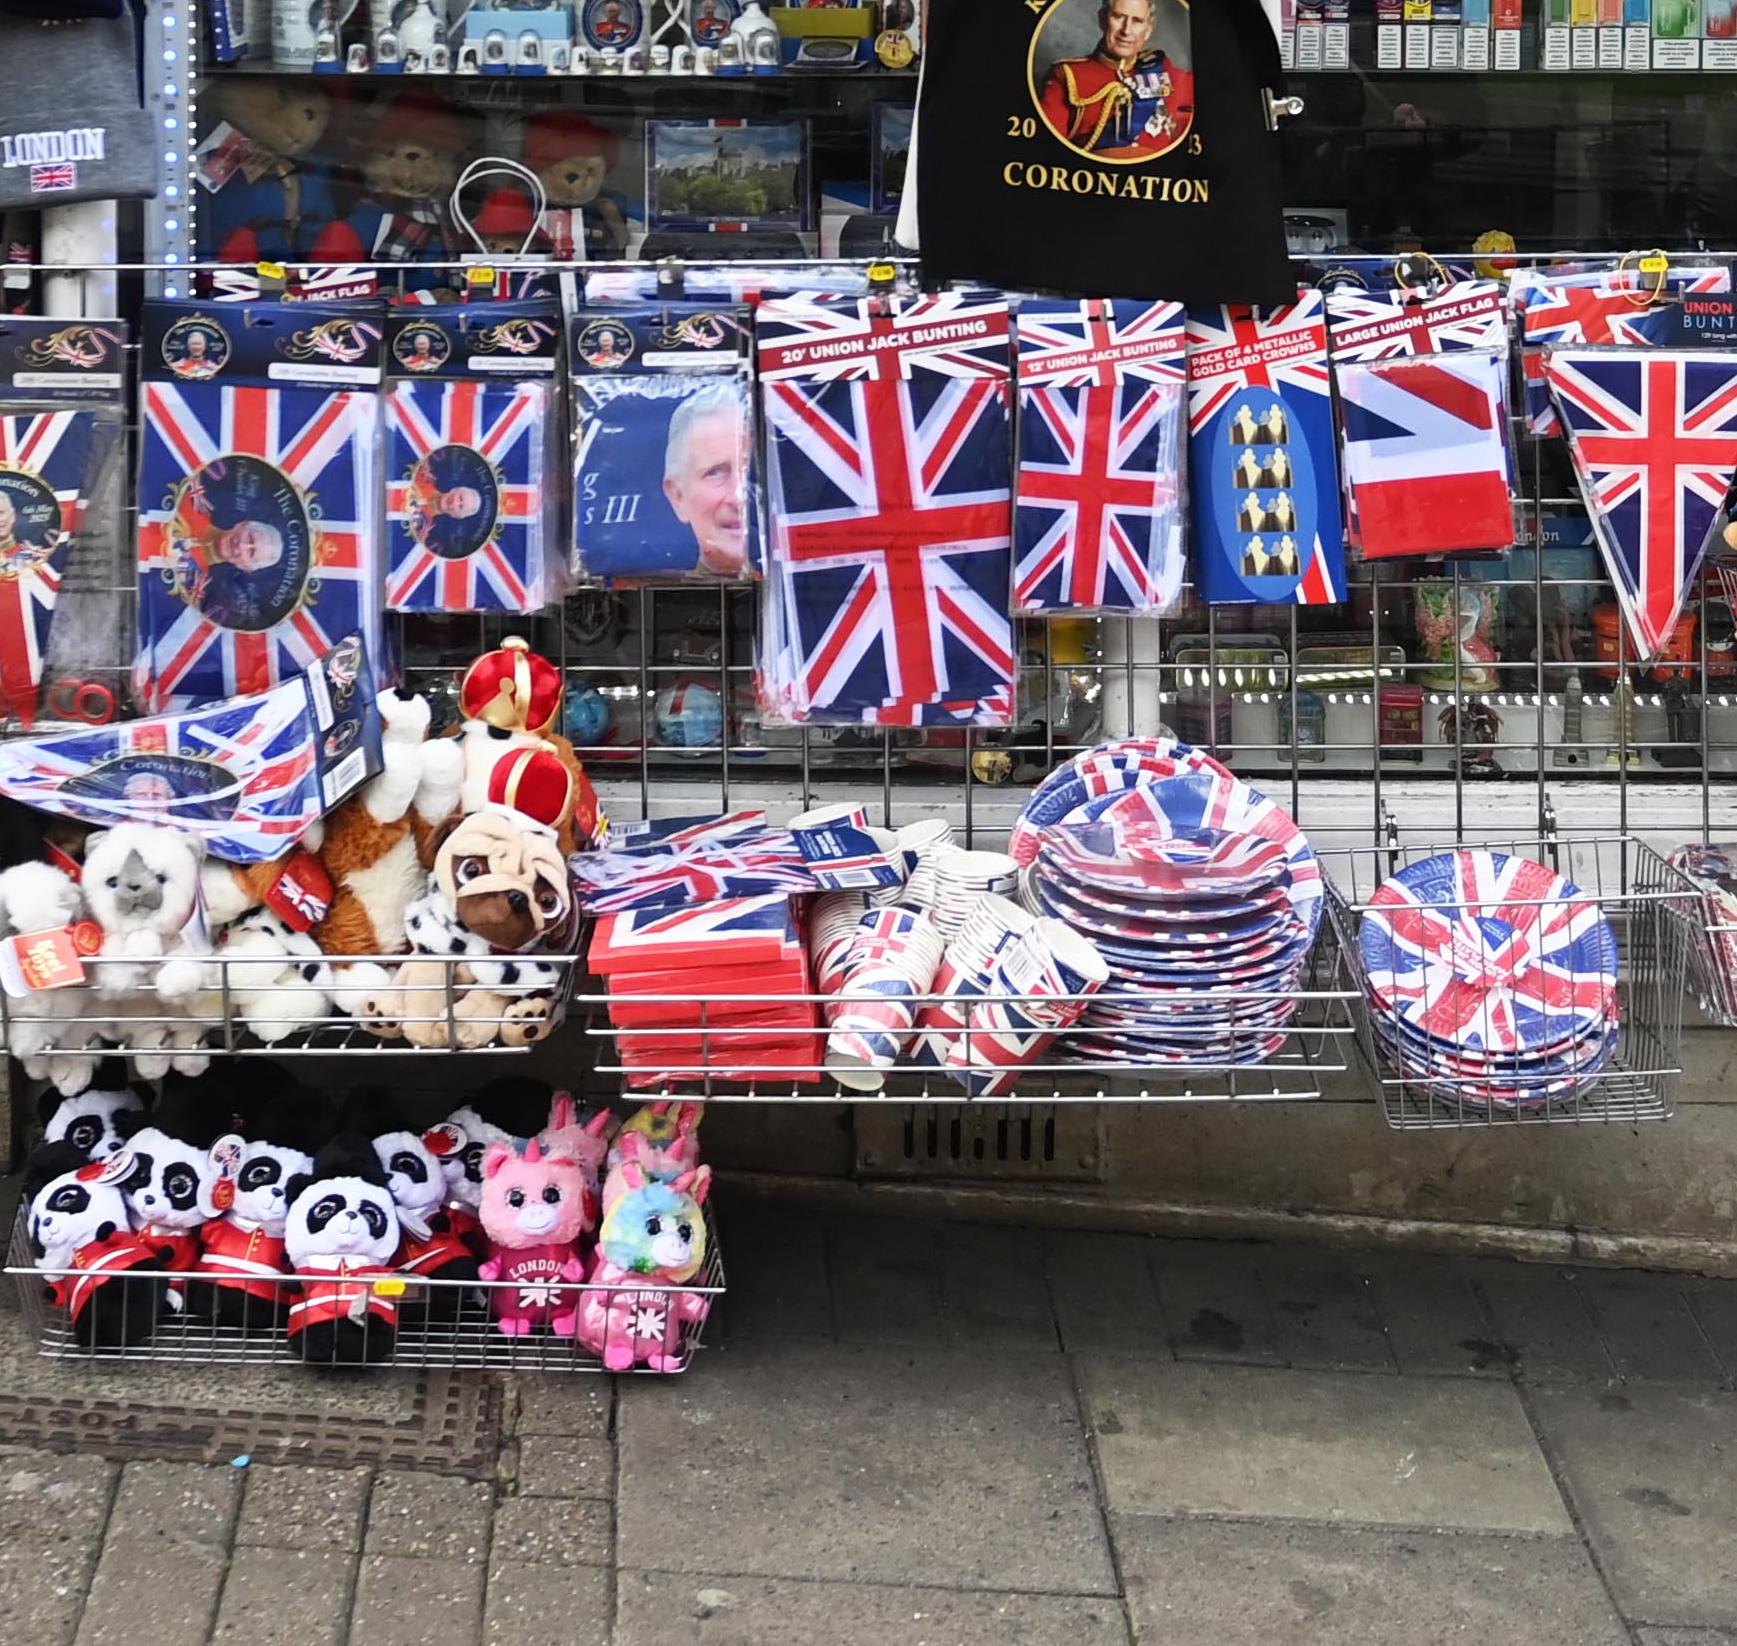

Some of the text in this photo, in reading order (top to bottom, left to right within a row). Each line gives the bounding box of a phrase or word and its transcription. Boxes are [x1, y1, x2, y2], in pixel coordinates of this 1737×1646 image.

[1007, 115, 1038, 138] 20
[0, 127, 106, 167] LONDON
[1002, 161, 1210, 204] CORONATION
[307, 282, 372, 303] JACK FLAG
[1683, 300, 1733, 317] UNION
[809, 337, 865, 362] UNION
[866, 331, 910, 353] JACK
[911, 318, 989, 348] BUNTING
[1335, 297, 1495, 347] LARGE UNION JACK FLAG
[1048, 354, 1086, 371] UNION
[1088, 348, 1119, 366] JACK
[1121, 337, 1178, 361] BUNTING
[1191, 329, 1313, 368] PACK OF METALLIC
[1192, 340, 1317, 379] GOLD CARD CROWNS
[601, 493, 642, 524] III
[269, 518, 304, 609] Coronation
